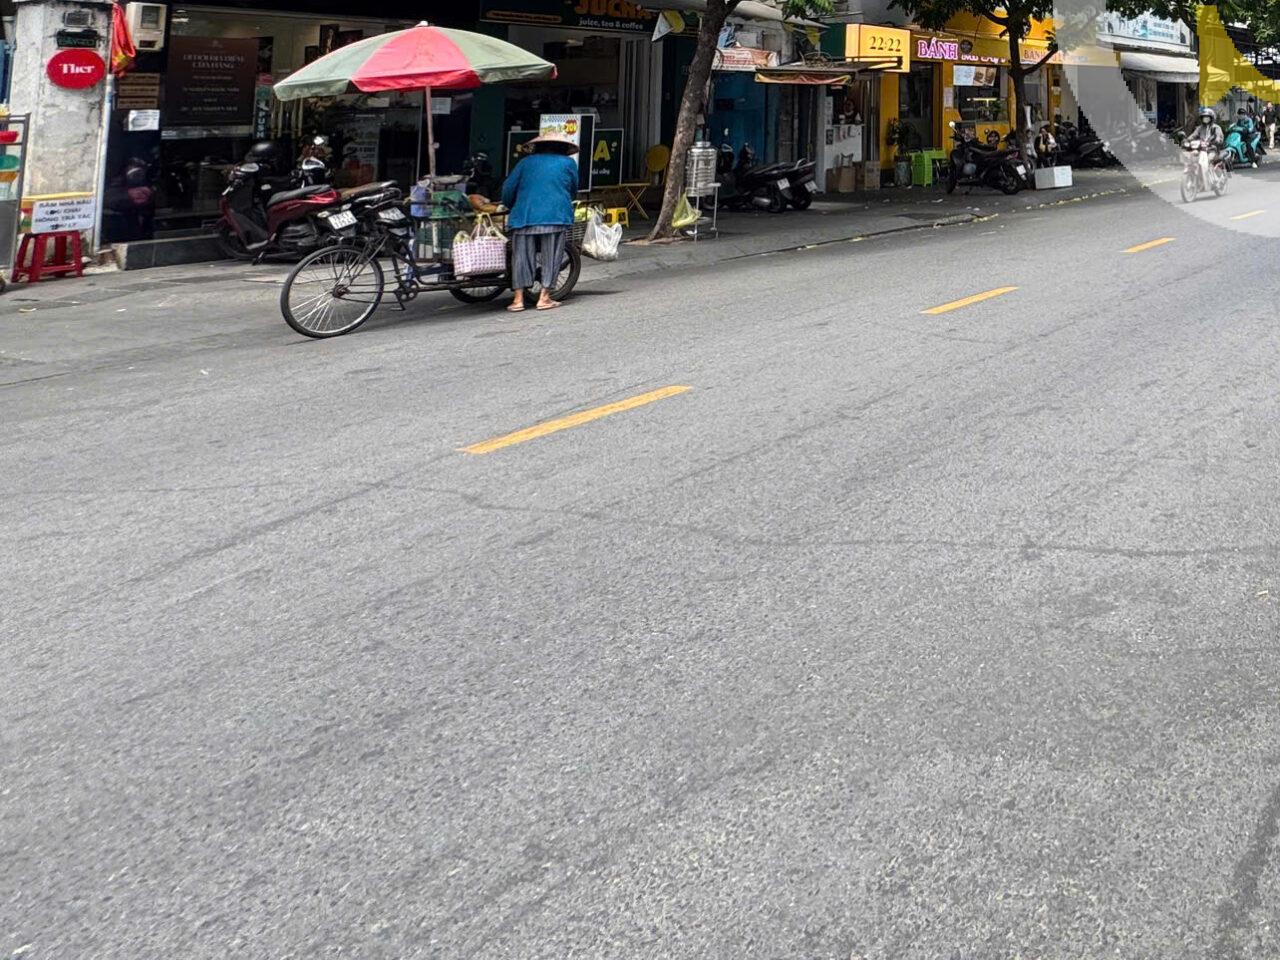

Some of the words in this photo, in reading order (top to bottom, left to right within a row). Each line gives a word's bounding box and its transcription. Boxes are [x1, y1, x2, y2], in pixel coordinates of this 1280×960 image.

[578, 17, 600, 27] juice,
[601, 19, 614, 27] tea
[621, 21, 644, 30] coffee
[917, 37, 958, 59] BÁNH
